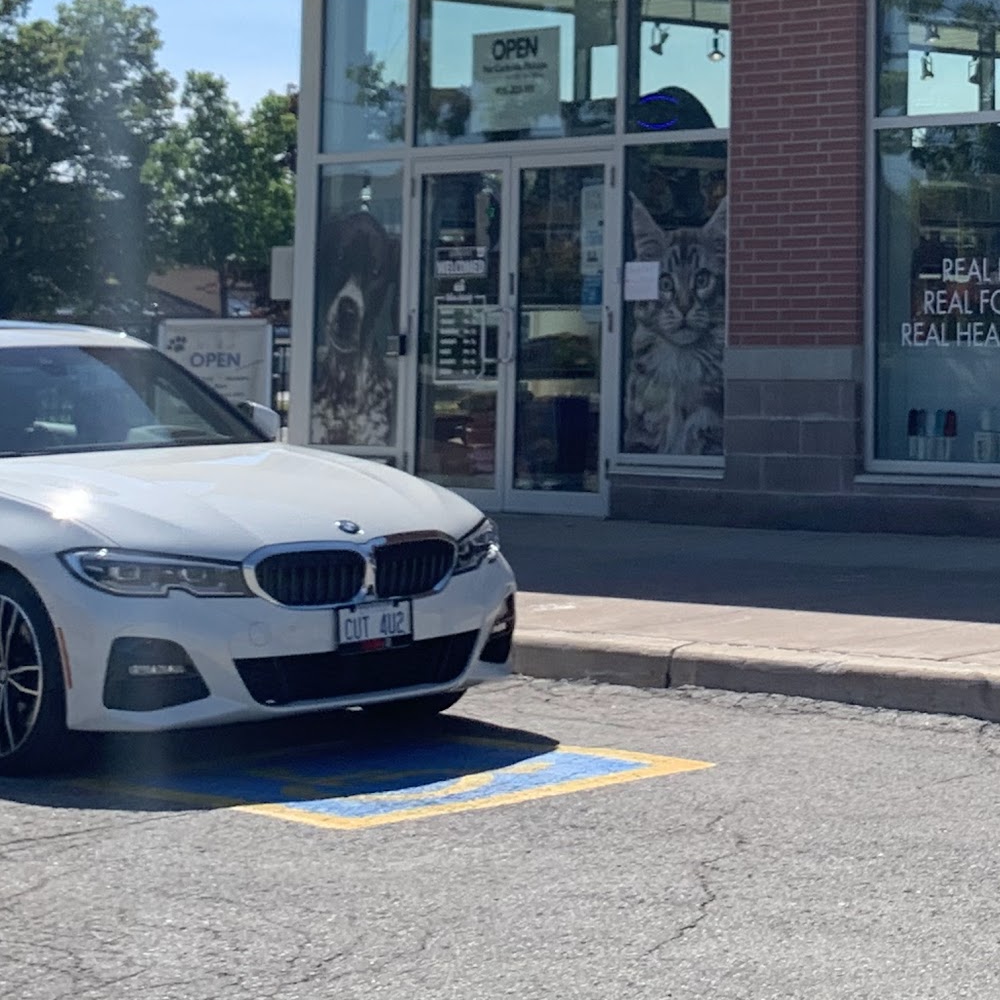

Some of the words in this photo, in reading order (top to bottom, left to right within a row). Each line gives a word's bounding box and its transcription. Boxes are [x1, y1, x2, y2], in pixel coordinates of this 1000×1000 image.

[491, 35, 538, 61] OPEN
[941, 257, 992, 283] REAL
[923, 289, 973, 315] REAL
[901, 322, 949, 347] REAL
[189, 351, 241, 368] OPEN
[344, 615, 370, 641] CUT
